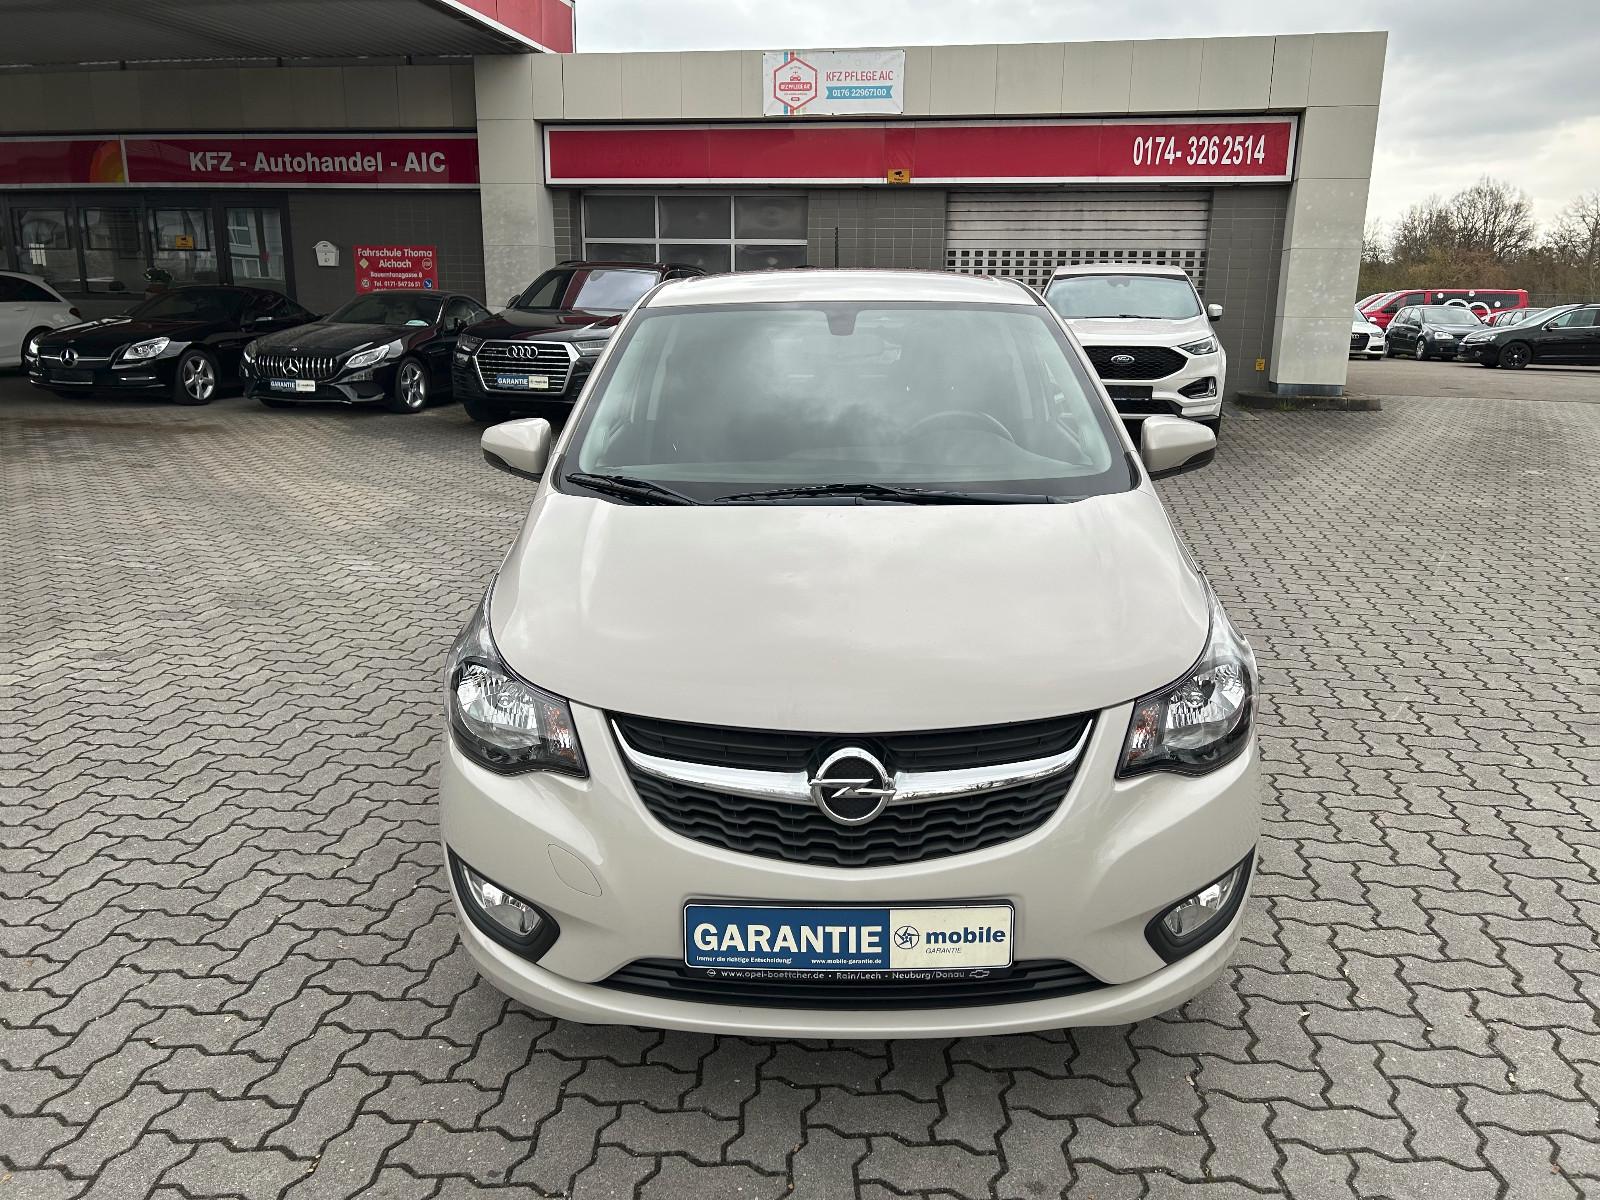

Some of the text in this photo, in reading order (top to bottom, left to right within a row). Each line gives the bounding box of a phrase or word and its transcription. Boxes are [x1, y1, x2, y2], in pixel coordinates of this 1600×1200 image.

[826, 70, 894, 82] KFZ PFLEGE AIC
[832, 88, 887, 97] 0176 22967100
[1133, 136, 1182, 166] 0174-
[189, 151, 234, 172] KFZ
[254, 151, 383, 172] Autohandel
[404, 151, 446, 172] AIC
[357, 248, 433, 257] Fahrschule Thoma
[379, 259, 412, 268] Aichach
[498, 377, 529, 385] GARANTIE
[693, 923, 882, 954] GARANTIE
[925, 926, 1006, 944] mobile
[726, 956, 750, 964] richtige
[750, 957, 792, 965] Entscheidung!
[811, 957, 882, 965] www.mobile-garantie.de
[720, 970, 965, 980] www.opel-boettcher.de Rain/Lech Neuburg/Donau
